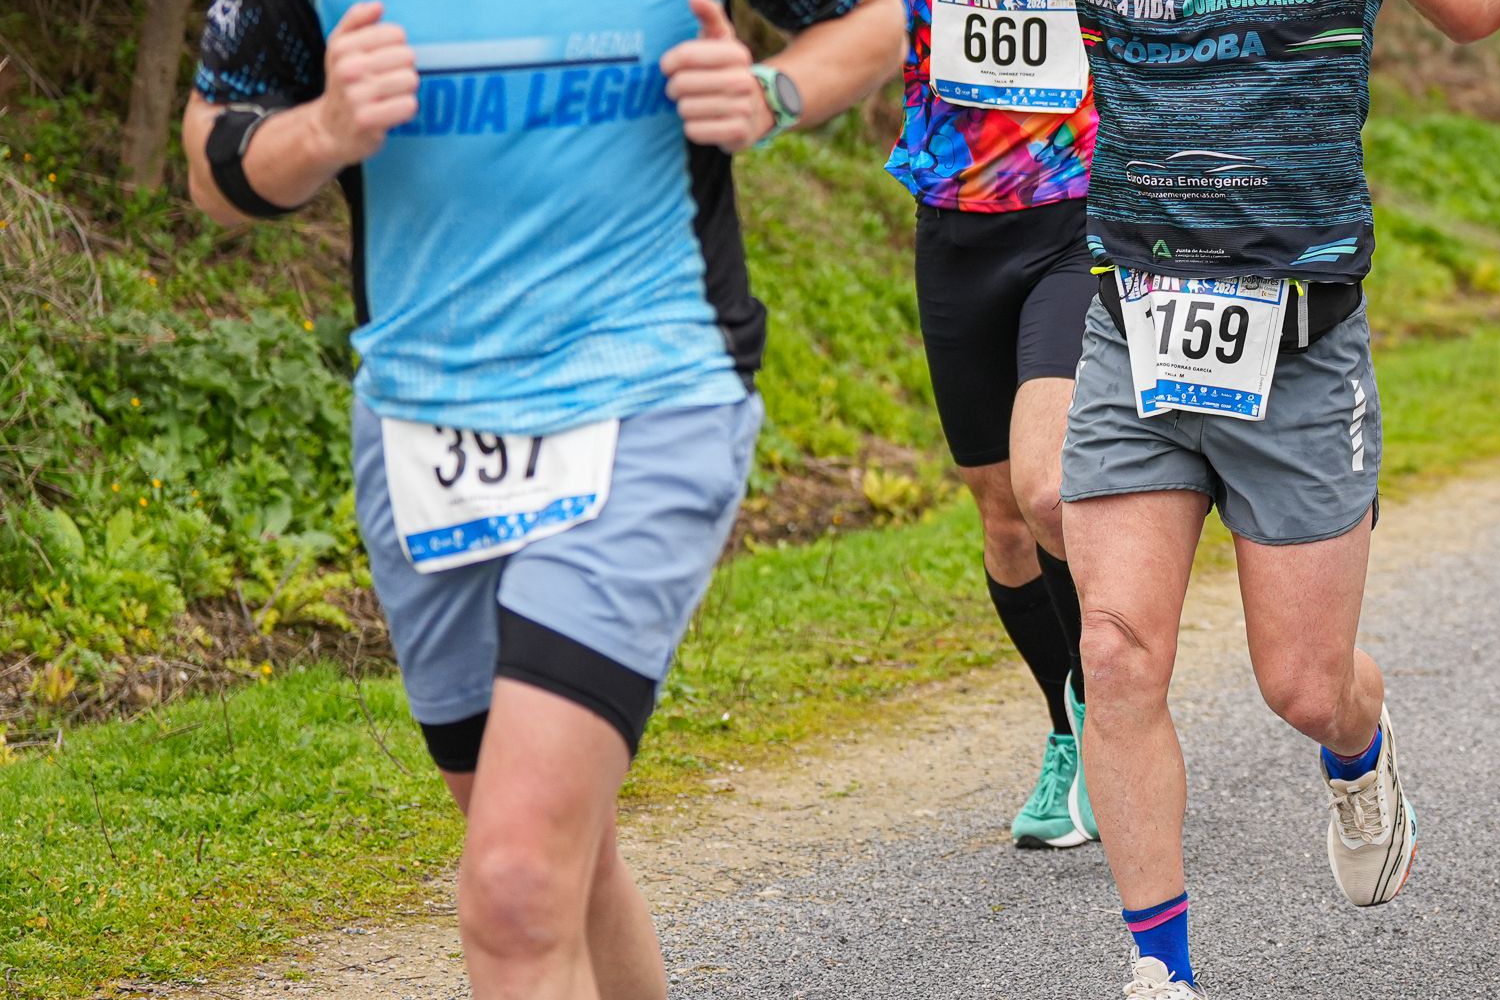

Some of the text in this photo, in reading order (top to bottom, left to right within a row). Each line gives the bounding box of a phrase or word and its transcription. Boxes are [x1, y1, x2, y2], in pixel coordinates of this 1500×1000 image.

[964, 13, 1047, 67] 660
[1106, 30, 1266, 64] CÓRDOBA
[1126, 171, 1269, 188] EuroGaza Emergencias
[1212, 281, 1236, 294] 2026
[1156, 299, 1250, 364] 159
